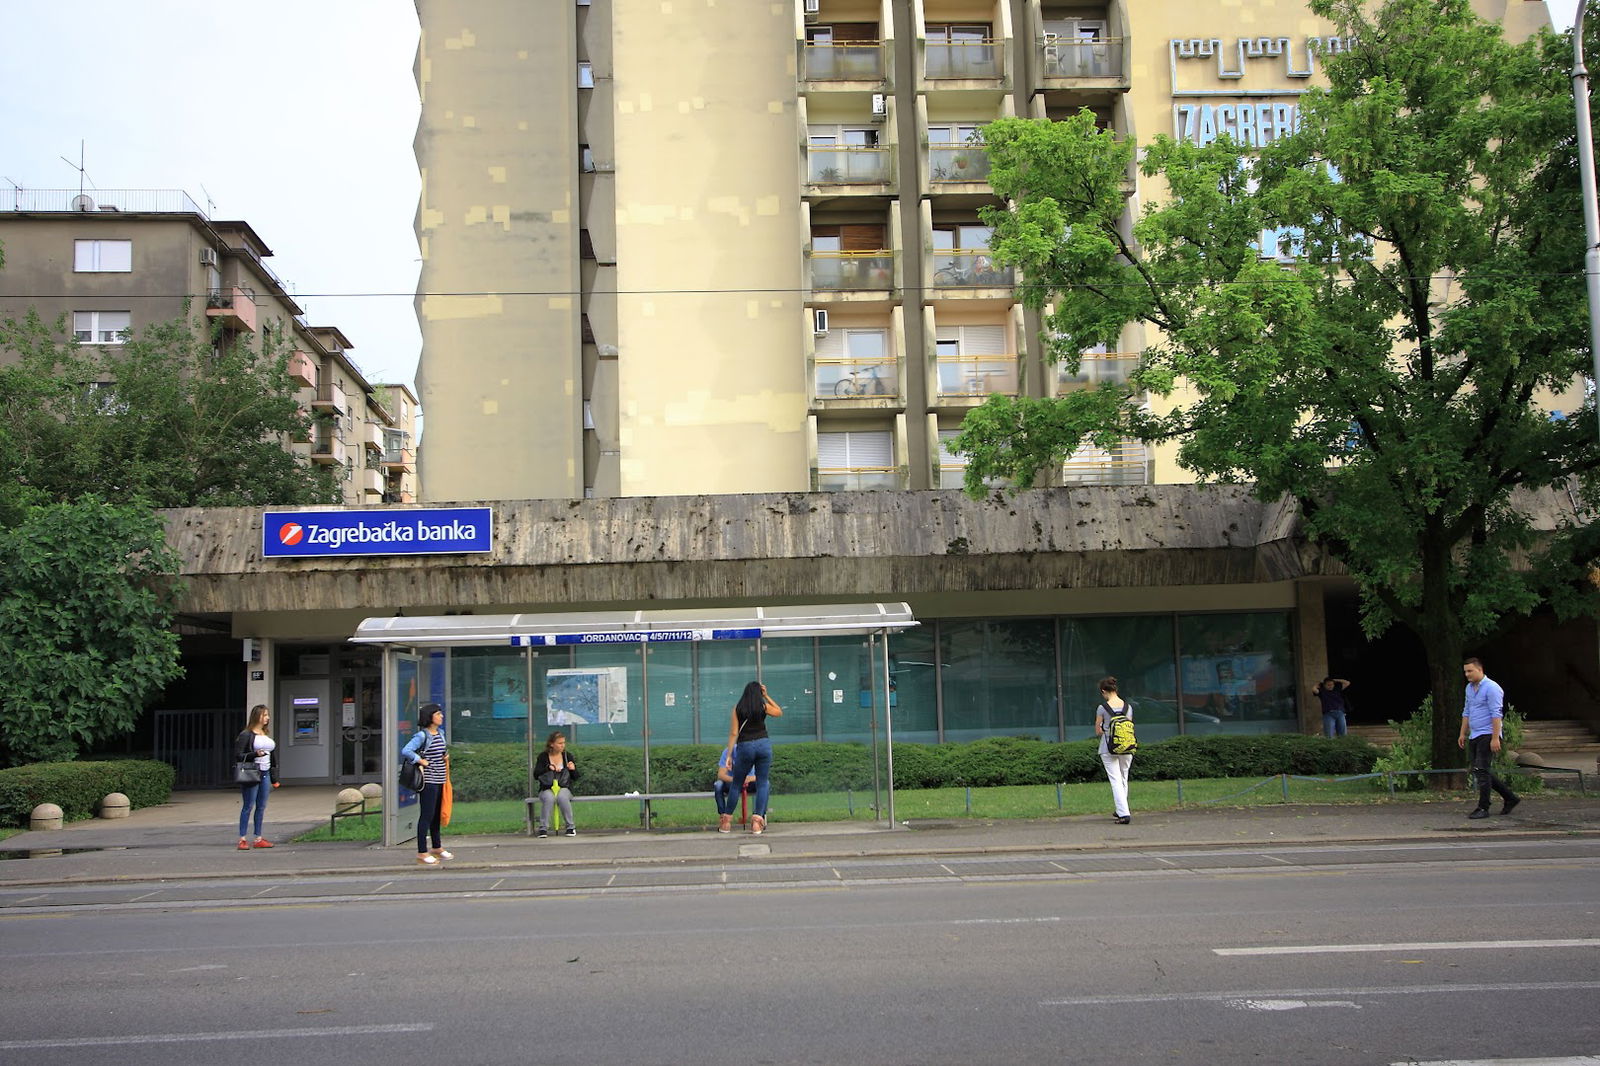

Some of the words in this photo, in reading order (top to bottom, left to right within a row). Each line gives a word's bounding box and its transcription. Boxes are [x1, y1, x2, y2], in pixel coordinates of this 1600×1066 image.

[308, 522, 413, 548] Zagrebačka
[418, 519, 476, 542] banka
[581, 633, 641, 643] JORDANOVAC
